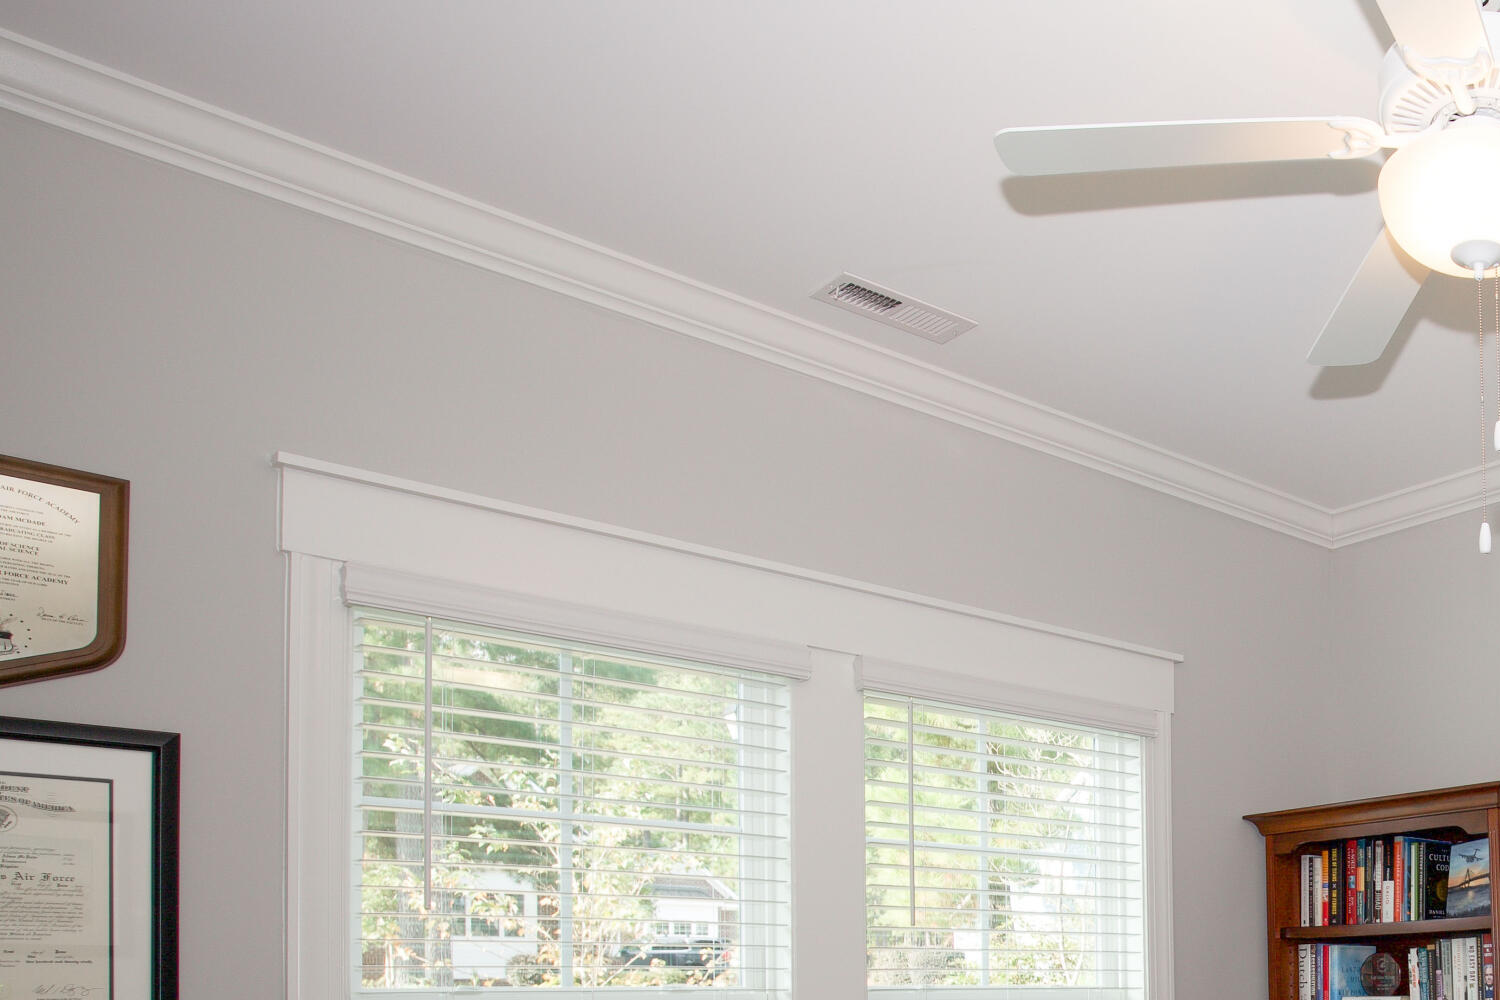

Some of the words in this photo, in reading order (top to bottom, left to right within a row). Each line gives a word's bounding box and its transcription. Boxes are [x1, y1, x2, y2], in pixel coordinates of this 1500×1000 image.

[18, 488, 44, 502] FORCE
[46, 501, 81, 524] ACADEMY
[9, 547, 39, 556] SCIENCE
[10, 542, 40, 552] SCIENCE
[4, 570, 29, 580] FORCE
[31, 575, 69, 586] ACADEMY
[14, 871, 35, 881] Air
[40, 872, 75, 883] Force
[1468, 945, 1475, 953] NO
[1298, 948, 1308, 989] Dutch
